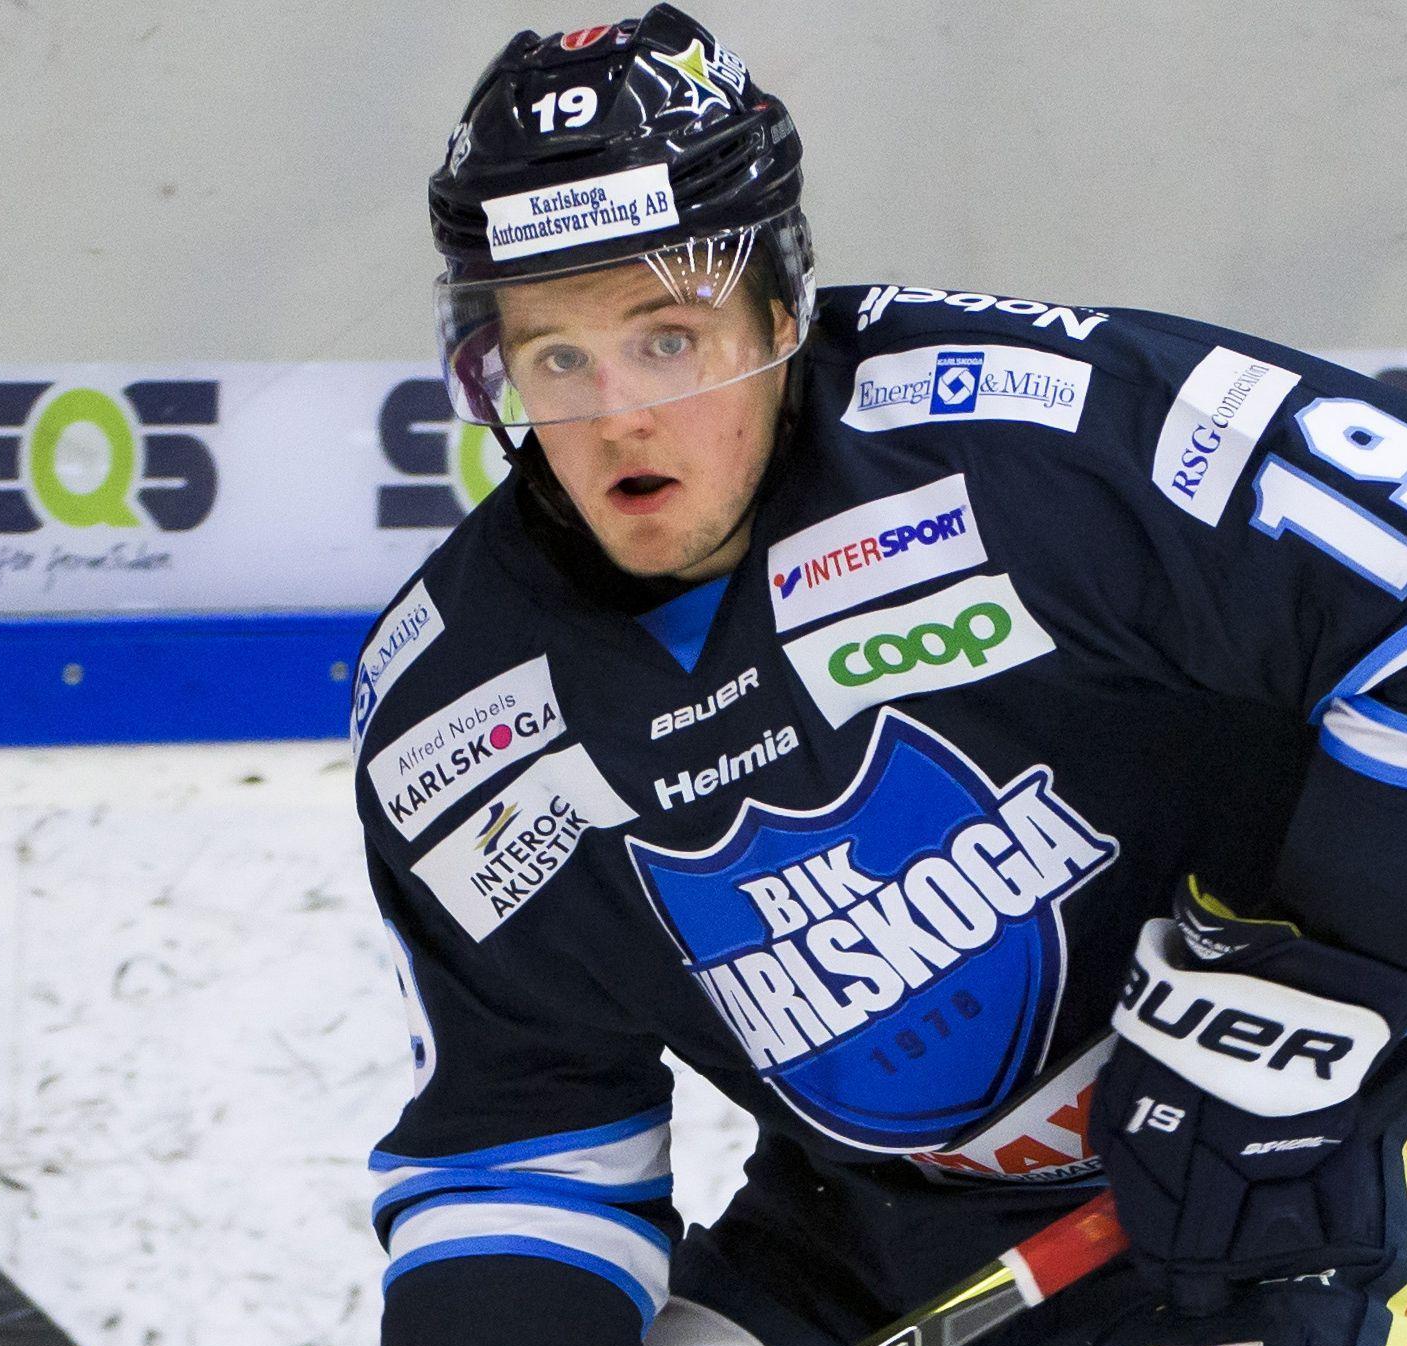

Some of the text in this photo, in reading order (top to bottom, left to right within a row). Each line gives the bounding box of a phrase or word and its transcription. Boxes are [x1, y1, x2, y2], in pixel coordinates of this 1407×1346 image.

[532, 86, 598, 133] 19
[491, 190, 670, 247] Automatsvarvning AB
[530, 183, 608, 216] Karlskoga
[858, 369, 1076, 410] Energi & Miljö
[803, 507, 968, 590] INTERSPORT
[377, 604, 430, 665] Miljö
[828, 602, 1012, 687] coop
[398, 693, 516, 776] Alfred Nobels
[653, 725, 800, 811] Helmia
[470, 795, 571, 897] INTEROC
[490, 808, 591, 919] AKUSTIK
[738, 841, 885, 938] BIK
